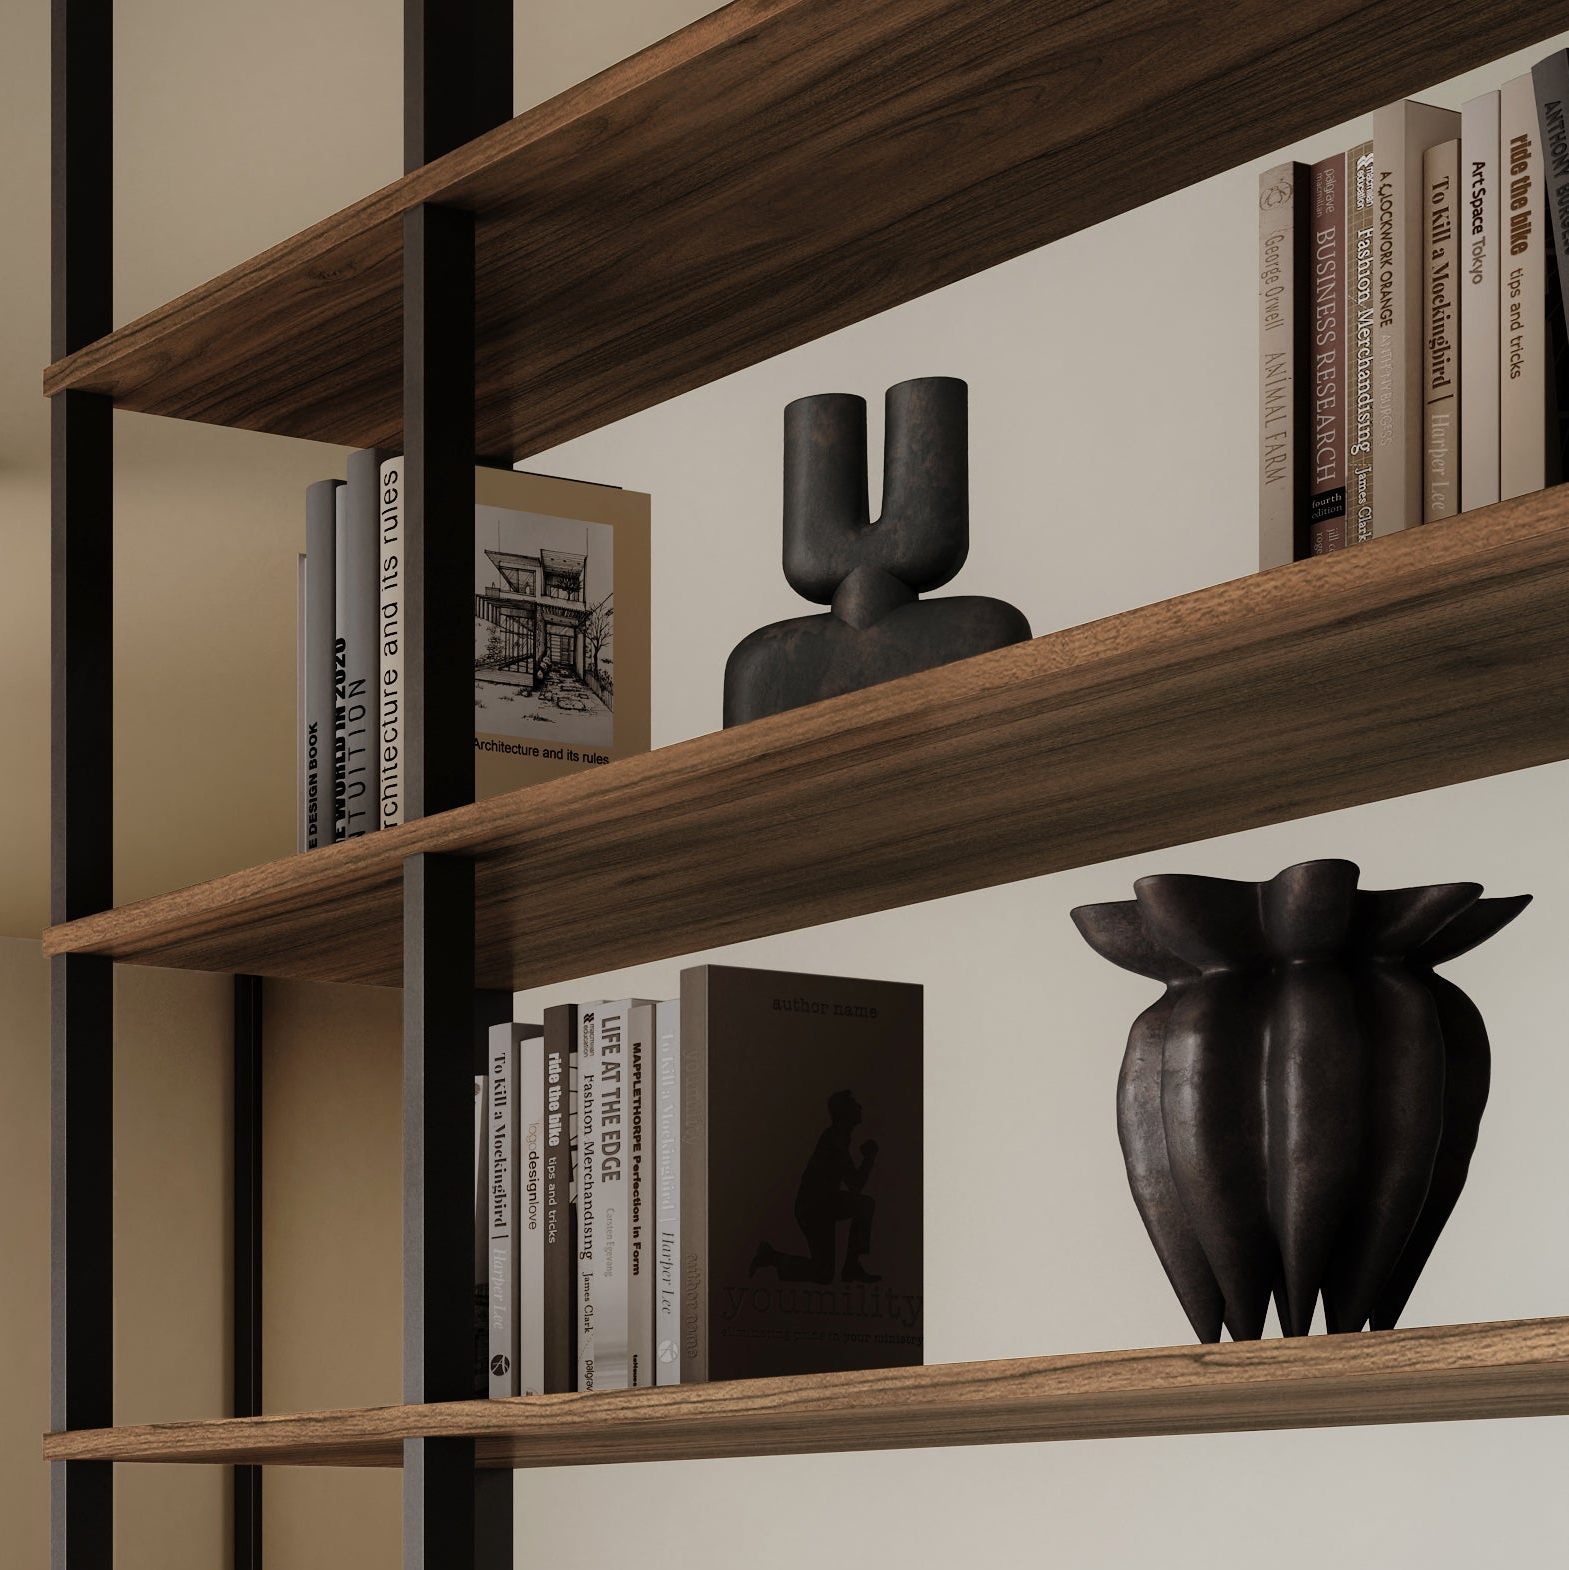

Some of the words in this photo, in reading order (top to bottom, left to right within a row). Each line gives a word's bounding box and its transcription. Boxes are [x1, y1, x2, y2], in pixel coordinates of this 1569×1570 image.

[1510, 133, 1532, 176] ride
[1323, 168, 1335, 213] palgrave
[1380, 171, 1392, 182] A
[1432, 176, 1450, 205] To
[1472, 161, 1486, 189] Art
[1510, 176, 1532, 211] the
[1432, 205, 1451, 244] Kill
[1469, 187, 1486, 235] Space
[1510, 210, 1532, 256] bike
[1261, 234, 1285, 285] George
[1432, 248, 1445, 261] a
[1469, 235, 1486, 285] Tokyo
[1316, 226, 1336, 346] BUSINESS
[1380, 271, 1393, 328] ORANGE
[1507, 267, 1523, 298] tips
[1265, 286, 1285, 331] Orwell
[1429, 261, 1451, 389] Mockingbird
[1510, 303, 1524, 331] and
[1510, 335, 1524, 380] tricks
[1316, 350, 1336, 484] RESEARCH
[1265, 431, 1287, 485] FARM
[1429, 413, 1450, 476] Harper
[1312, 493, 1342, 509] fourth
[1355, 466, 1372, 504] James
[1432, 481, 1449, 510] Lee
[382, 470, 398, 544] rules
[1311, 504, 1343, 519] edition
[382, 555, 398, 591] its
[382, 601, 398, 656] and
[309, 721, 318, 769] BOOK
[473, 737, 540, 757] Architecture
[542, 748, 564, 760] and
[566, 749, 580, 762] its
[582, 752, 610, 765] rules
[309, 773, 318, 836] DESIGN
[771, 997, 829, 1016] author
[833, 1002, 879, 1020] name
[601, 1015, 620, 1056] LIFE
[494, 1052, 506, 1074] To
[549, 1052, 562, 1083] ride
[601, 1061, 620, 1083] AT
[494, 1078, 507, 1107] Kill
[549, 1085, 562, 1111] the
[601, 1088, 620, 1126] THE
[633, 1042, 641, 1152] MAPPLETHORPE
[494, 1110, 503, 1120] a
[549, 1113, 562, 1147] bike
[547, 1157, 557, 1180] tips
[601, 1130, 620, 1183] EDGE
[492, 1124, 507, 1228] Mockingbird
[548, 1182, 558, 1206] and
[633, 1155, 641, 1223] Perfection
[579, 1141, 595, 1260] Merchandising
[548, 1209, 558, 1244] tricks
[633, 1225, 641, 1239] in
[491, 1249, 506, 1302] Harper
[633, 1240, 641, 1276] Form
[660, 1231, 674, 1286] Harper
[582, 1272, 593, 1302] James
[662, 1290, 674, 1314] Lee
[493, 1304, 507, 1330] Lee
[584, 1304, 594, 1333] Clark
[719, 1285, 924, 1328] youmility
